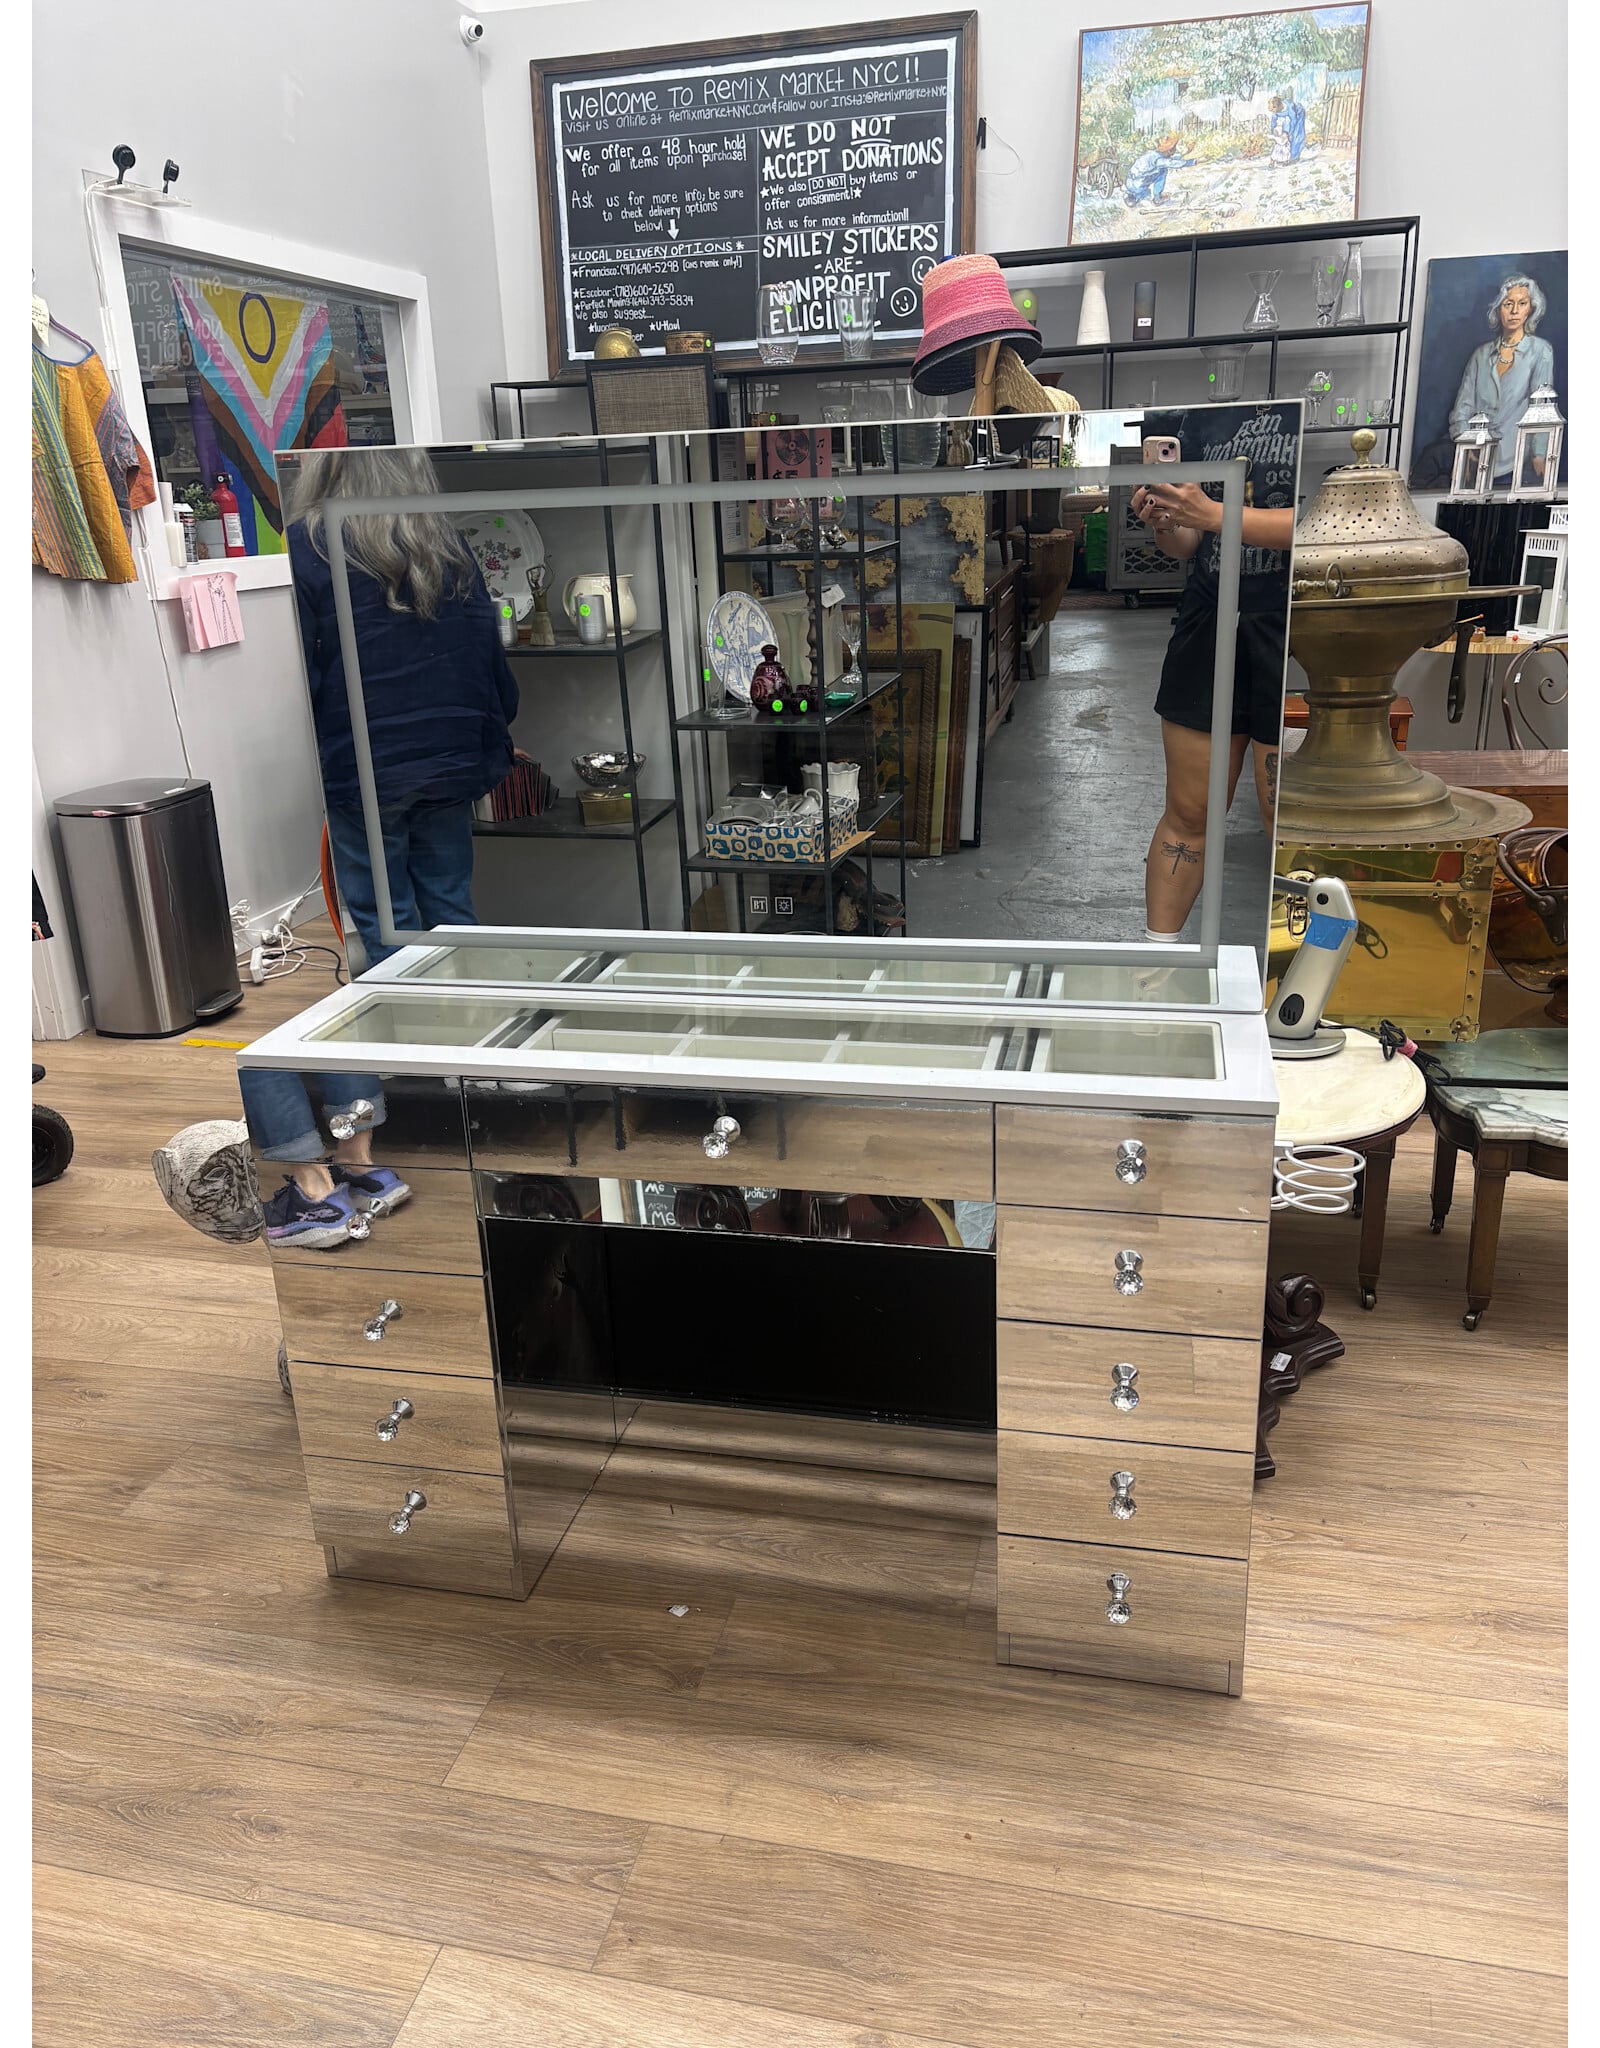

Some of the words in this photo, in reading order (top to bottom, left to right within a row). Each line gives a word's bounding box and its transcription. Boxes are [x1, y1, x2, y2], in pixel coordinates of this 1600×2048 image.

[616, 115, 648, 128] online
[810, 99, 829, 110] our
[760, 125, 796, 150] WE
[807, 121, 836, 145] DO
[851, 116, 896, 140] NOT
[566, 146, 591, 163] We
[601, 144, 633, 160] offer
[642, 146, 651, 157] a
[661, 137, 680, 156] 48
[689, 139, 717, 154] hour
[724, 133, 746, 150] hold
[762, 148, 830, 181] ACCEPT
[842, 137, 944, 172] DONATIONS
[582, 162, 599, 178] for
[609, 159, 621, 173] all
[630, 156, 659, 170] items
[667, 153, 694, 170] upon
[702, 150, 747, 168] purchase!
[770, 185, 784, 197] We
[788, 181, 806, 193] also
[812, 178, 824, 189] DO
[827, 176, 844, 188] NOT
[850, 175, 866, 188] buy
[869, 171, 898, 184] items
[906, 170, 918, 180] or
[571, 189, 595, 209] Ask
[607, 195, 620, 208] us
[628, 191, 645, 207] for
[653, 192, 678, 205] more
[708, 187, 721, 200] be
[723, 188, 744, 200] sure
[765, 198, 790, 211] offer
[797, 187, 854, 208] consignment!
[602, 209, 612, 222] to
[621, 207, 643, 220] check
[649, 204, 681, 219] delivery
[685, 201, 718, 216] options
[766, 217, 784, 231] Ask
[788, 219, 799, 228] us
[803, 216, 818, 228] for
[822, 216, 846, 226] more
[634, 219, 664, 233] below!
[616, 244, 668, 260] DELIVERY
[670, 241, 733, 257] OPTIONS
[763, 231, 835, 259] SMILEY
[842, 224, 938, 255] STICKERS
[769, 271, 891, 308] NONPROFIT
[575, 311, 588, 320] We
[592, 310, 608, 319] also
[753, 900, 765, 910] BT
